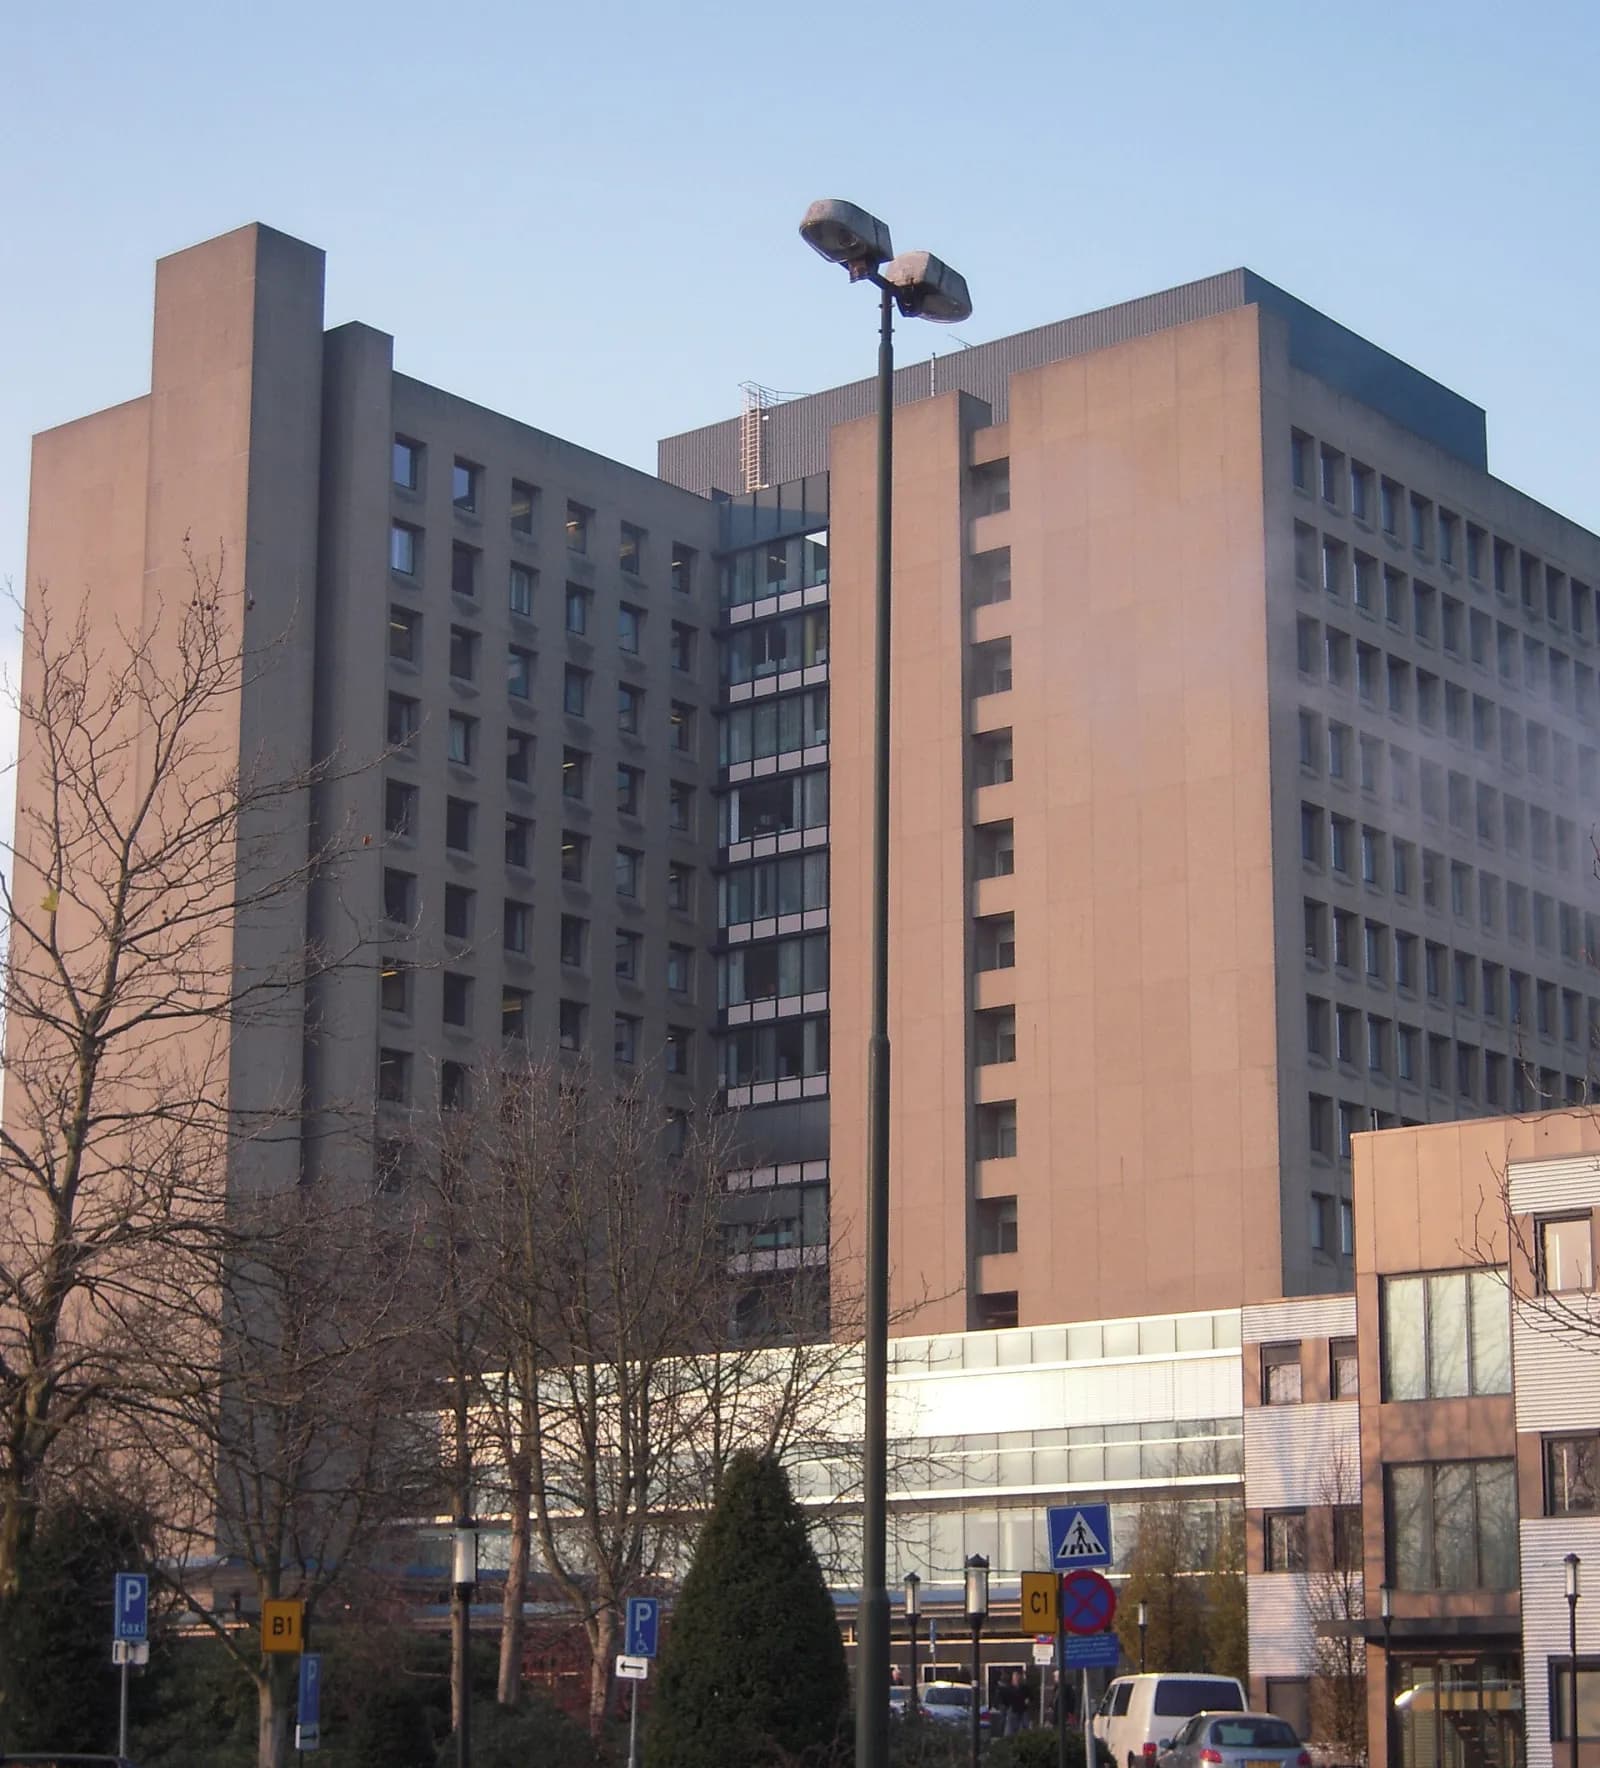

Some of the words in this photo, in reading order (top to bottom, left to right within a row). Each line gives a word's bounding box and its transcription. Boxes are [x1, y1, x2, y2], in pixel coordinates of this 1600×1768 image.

[125, 1580, 142, 1612] P
[1031, 1591, 1047, 1614] C1
[121, 1621, 144, 1635] taxi
[272, 1616, 293, 1635] B1
[635, 1602, 653, 1632] P
